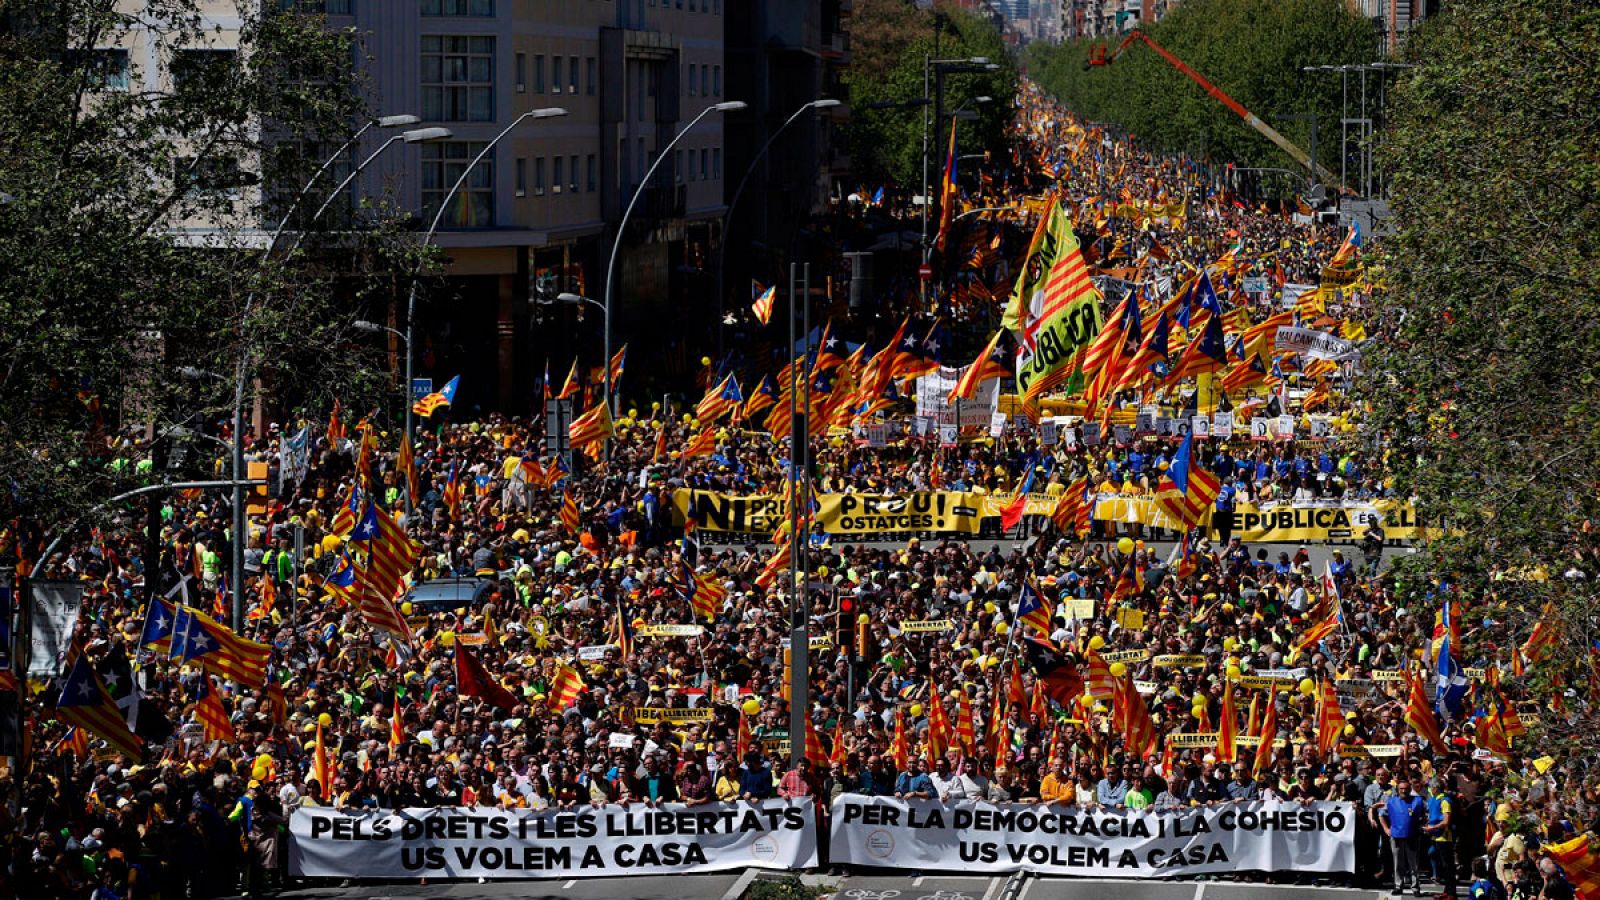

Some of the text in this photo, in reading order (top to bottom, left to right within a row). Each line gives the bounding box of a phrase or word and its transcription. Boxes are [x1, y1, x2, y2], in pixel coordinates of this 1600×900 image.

[697, 493, 746, 531] NI
[840, 514, 932, 530] OSTATGES
[310, 807, 805, 841] PELS DRETS I LES LLIBERTATS
[843, 803, 900, 826] PER
[907, 807, 945, 829] LA
[1173, 815, 1212, 838] LA
[1218, 805, 1346, 833] COHESIÓ
[401, 841, 709, 871] US VOLEM A CASA
[958, 841, 1229, 869] US VOLEM A CASA
